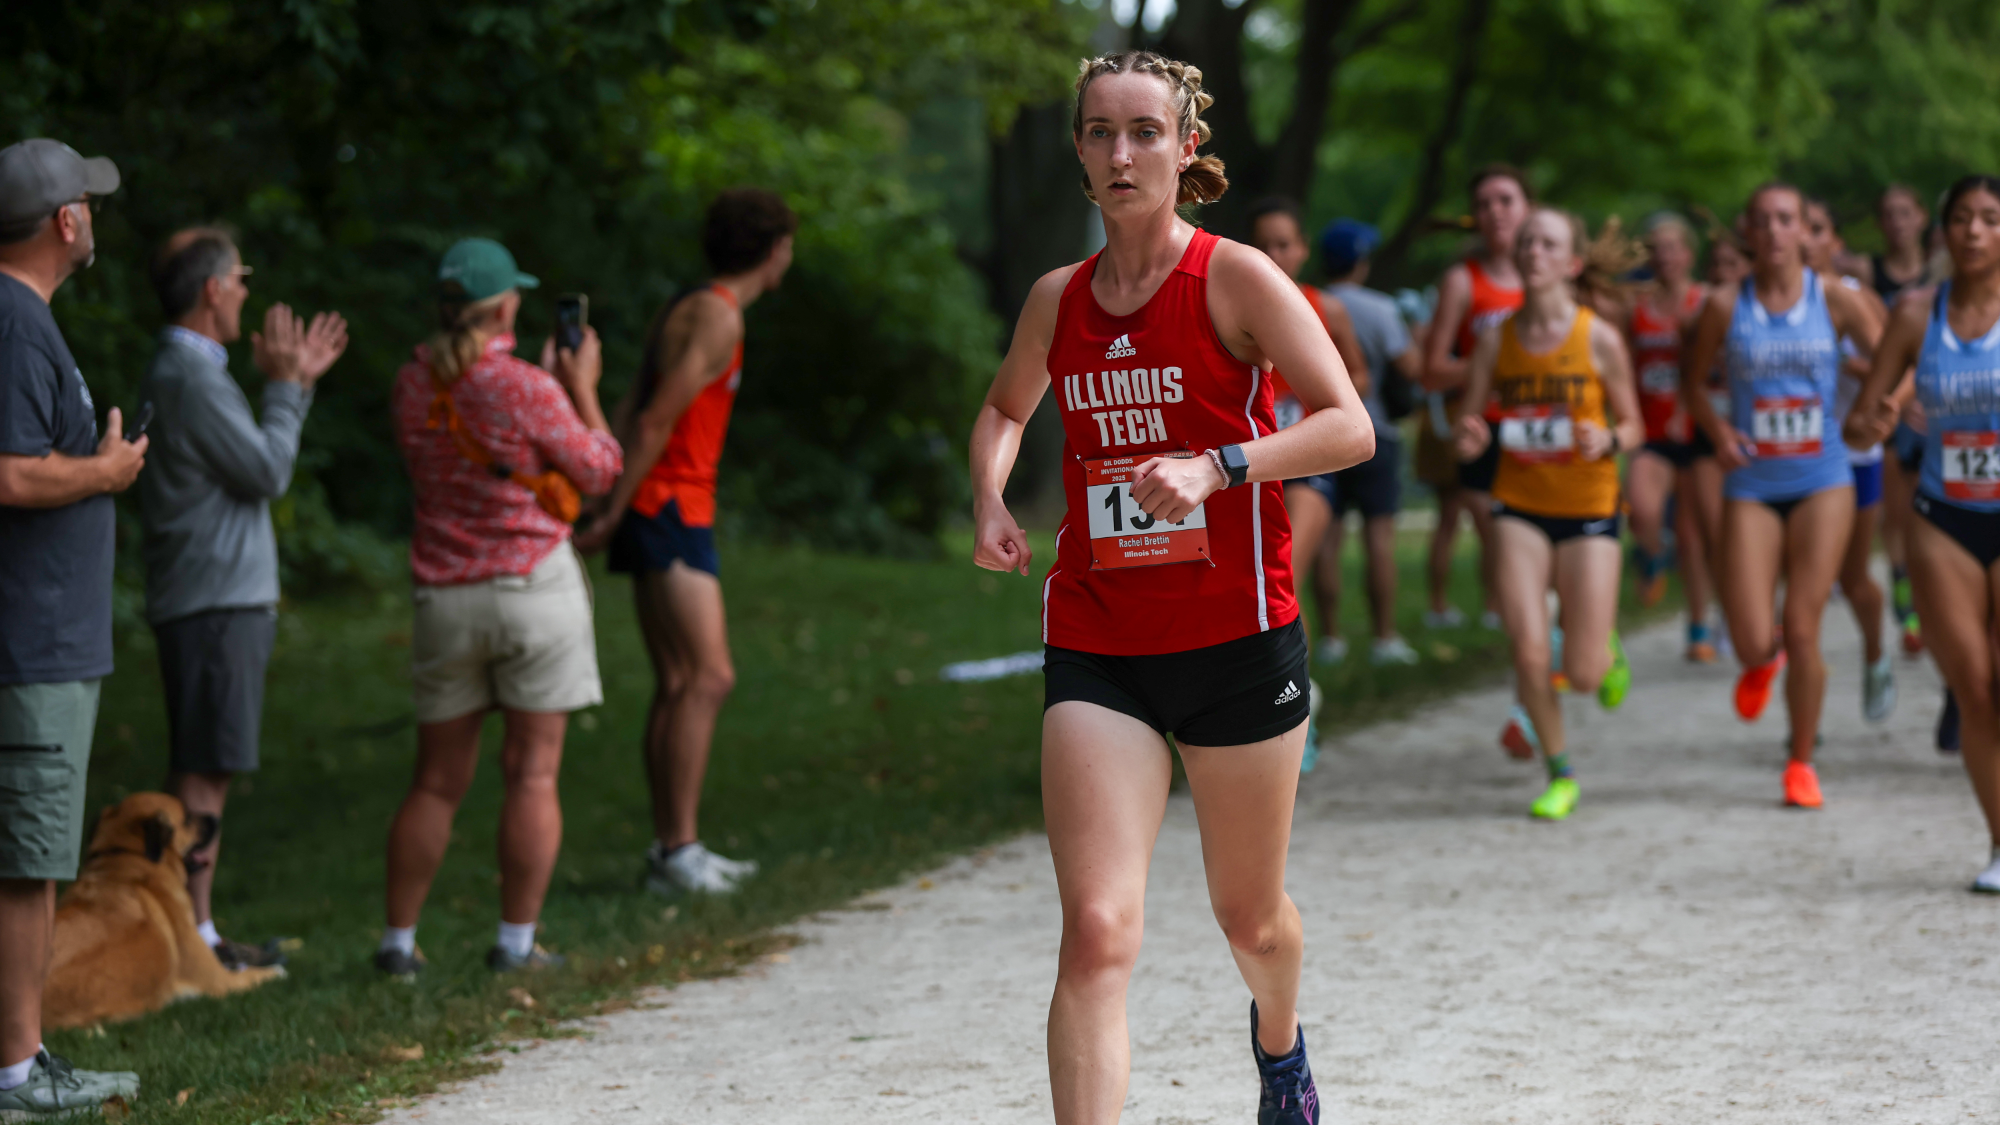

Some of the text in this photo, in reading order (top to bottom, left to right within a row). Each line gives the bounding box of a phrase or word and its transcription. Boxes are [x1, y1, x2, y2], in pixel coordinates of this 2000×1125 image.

[1105, 346, 1137, 360] adidas
[1064, 366, 1184, 411] ILLINOIS
[1091, 408, 1168, 447] TECH
[1113, 458, 1134, 466] DODDS
[1101, 466, 1136, 475] INVITATIONA
[1119, 535, 1170, 548] Rachel Brettin
[1124, 548, 1169, 558] Illinois Tech
[1274, 689, 1301, 705] adidas
